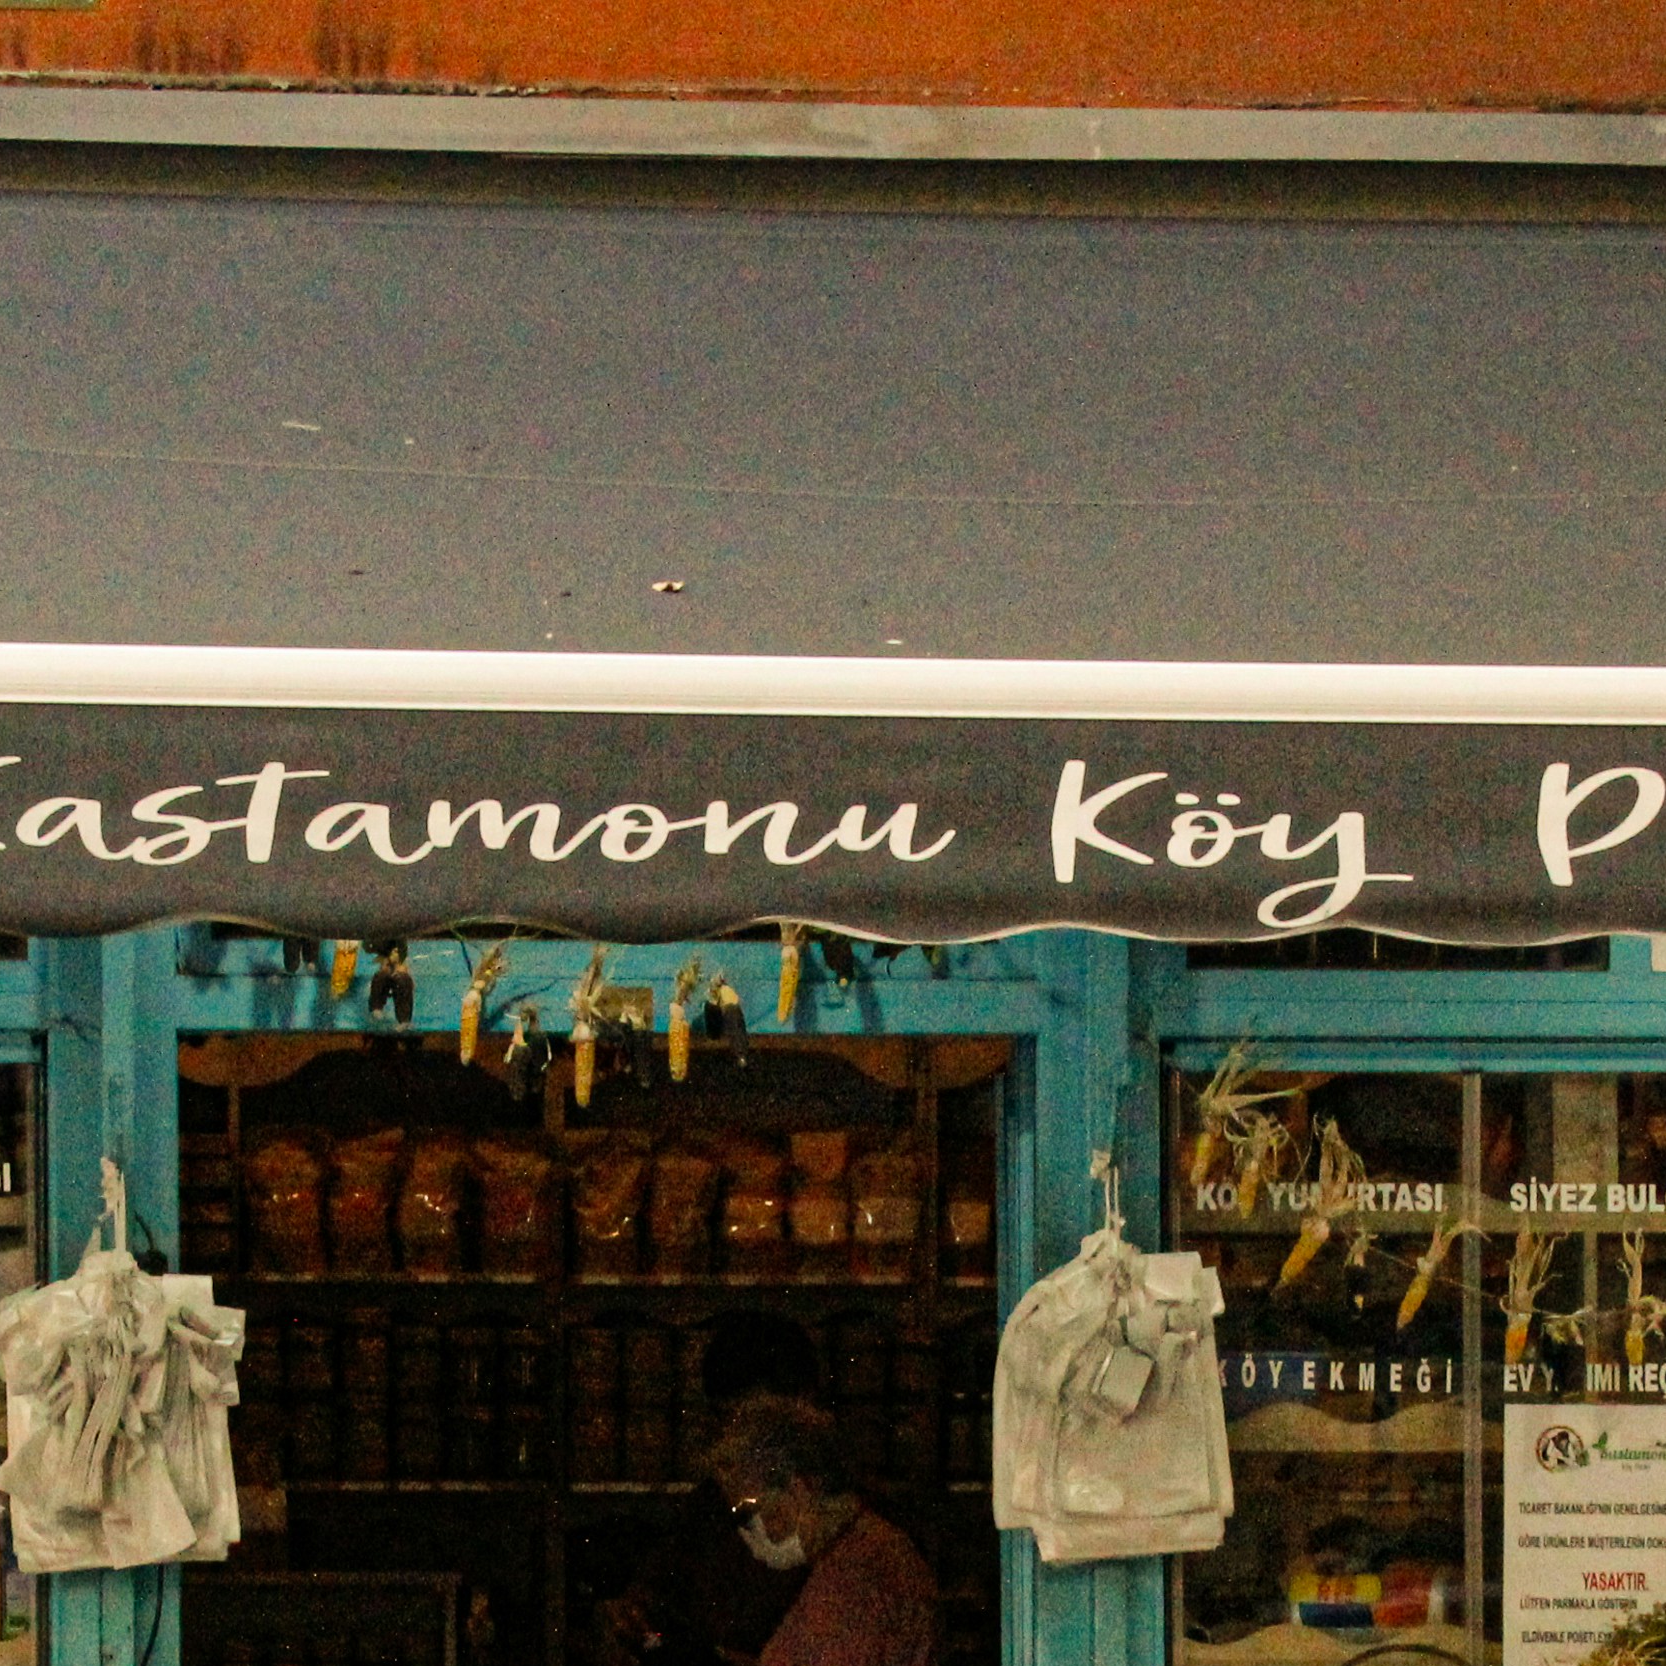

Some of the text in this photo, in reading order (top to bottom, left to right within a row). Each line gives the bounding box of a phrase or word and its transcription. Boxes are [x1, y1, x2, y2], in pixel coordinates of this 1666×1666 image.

[1050, 758, 1415, 929] Köy
[1509, 1176, 1597, 1213] SİYEZ
[1302, 1358, 1453, 1394] EKMEĞİ
[1503, 1362, 1534, 1392] EV
